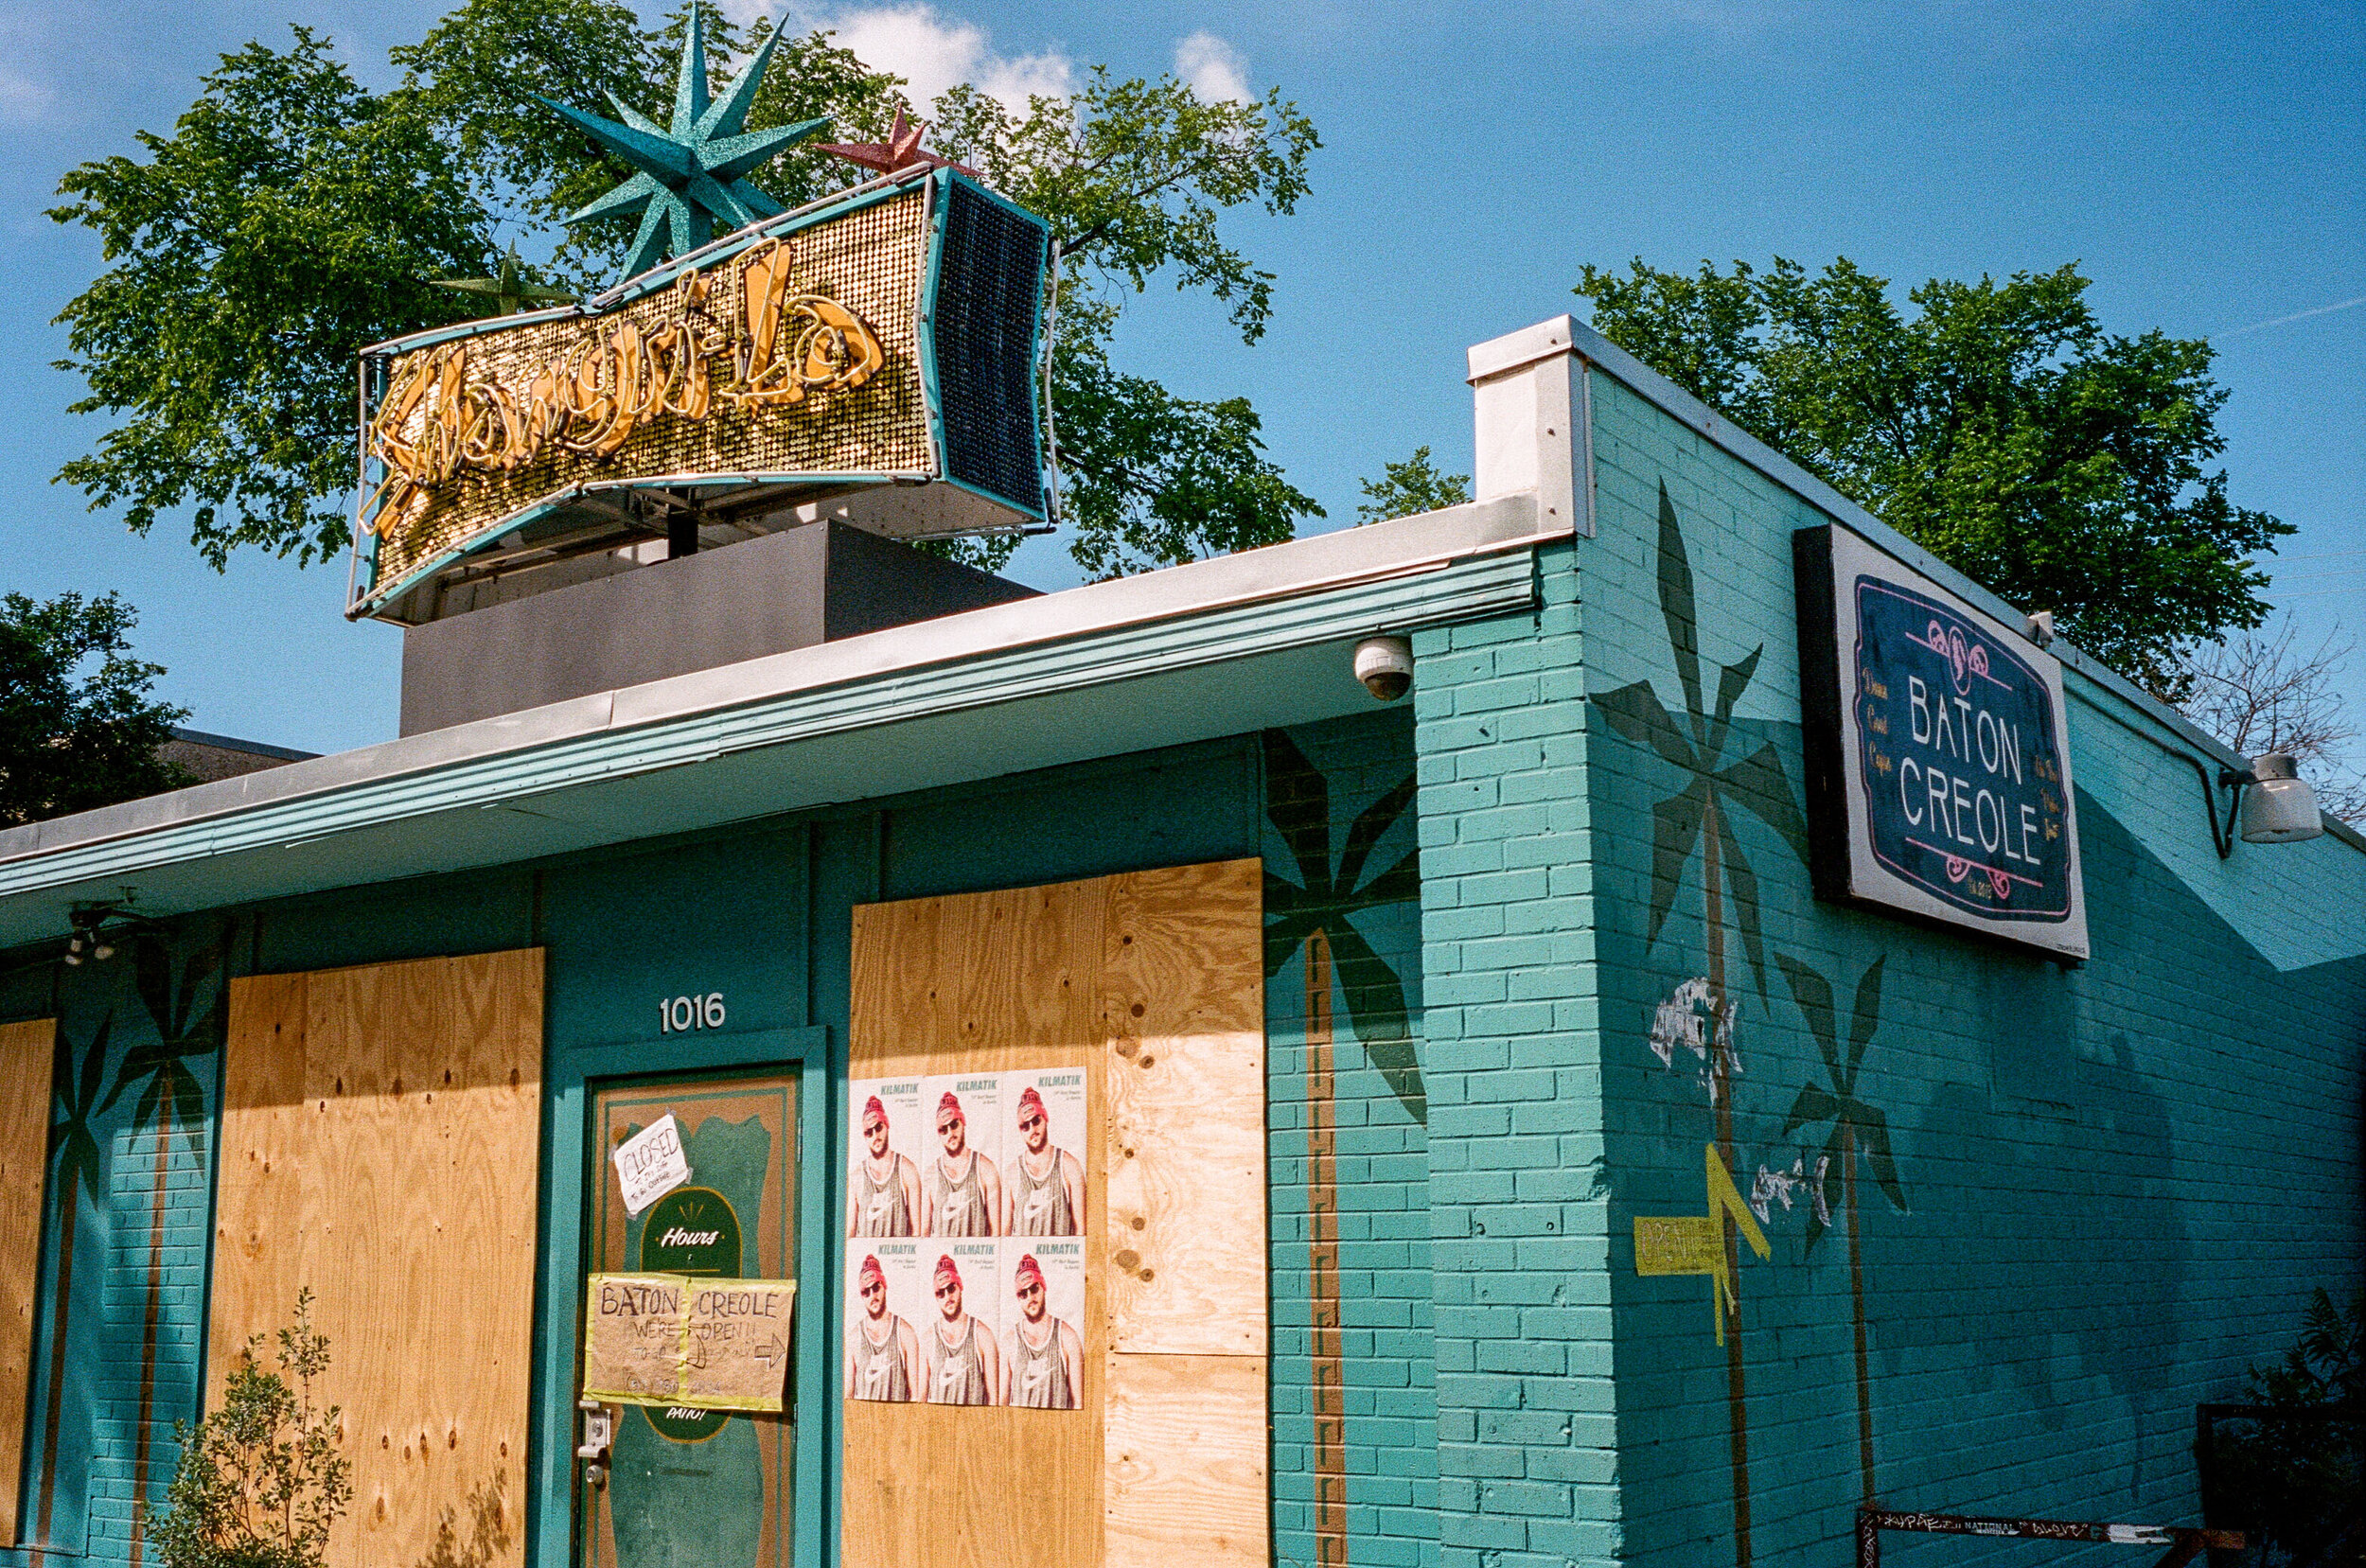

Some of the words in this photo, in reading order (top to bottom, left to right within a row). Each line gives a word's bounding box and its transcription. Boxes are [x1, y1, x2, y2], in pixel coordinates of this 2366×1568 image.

[359, 237, 883, 540] Shangri-La
[1909, 675, 2022, 785] BATON
[1900, 756, 2041, 866] CREOLE
[660, 992, 726, 1032] 1016
[880, 1083, 919, 1096] KILMATIK
[956, 1079, 998, 1092] KILMATIK
[1038, 1075, 1082, 1087] KILMATIK
[623, 1127, 680, 1182] CLOSED
[661, 1226, 719, 1248] Hours
[878, 1244, 917, 1255] KILMATIK
[954, 1243, 996, 1255] KILMATIK
[1035, 1243, 1080, 1255] KILMATIK
[600, 1286, 680, 1317] BATON
[697, 1291, 779, 1319] CREOLE
[1965, 1522, 2015, 1531] NATIONAL
